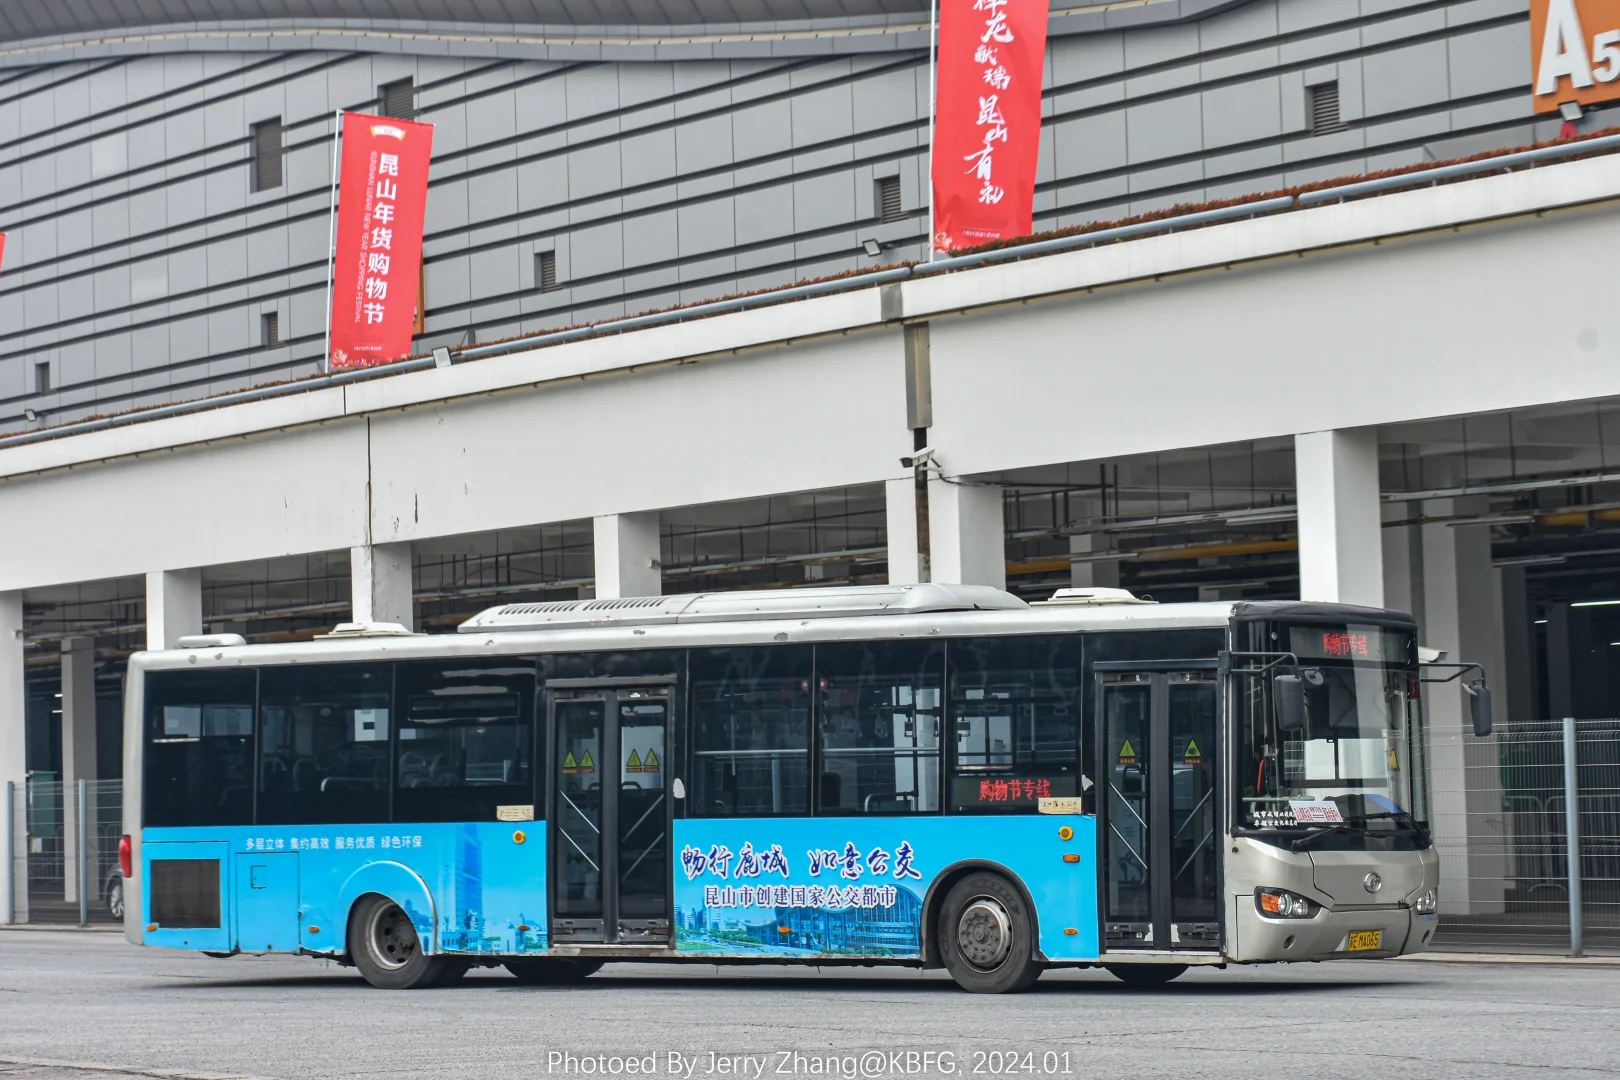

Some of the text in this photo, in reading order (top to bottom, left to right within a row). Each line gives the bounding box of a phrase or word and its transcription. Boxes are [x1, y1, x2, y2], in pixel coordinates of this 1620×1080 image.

[354, 150, 378, 324] KUNSHAN LUNAR NEW YEAR SHOPPING FESTIVAL
[364, 152, 399, 325] 昆山年货购物节
[1324, 632, 1368, 656] 购物节专线
[979, 779, 1051, 802] 购物节专线
[245, 835, 423, 851] 多层立体 集约高效 服务优质 绿色环保
[681, 840, 922, 880] 畅行鹿城 如意公交
[704, 885, 897, 908] 昆山市创建国家公交都市
